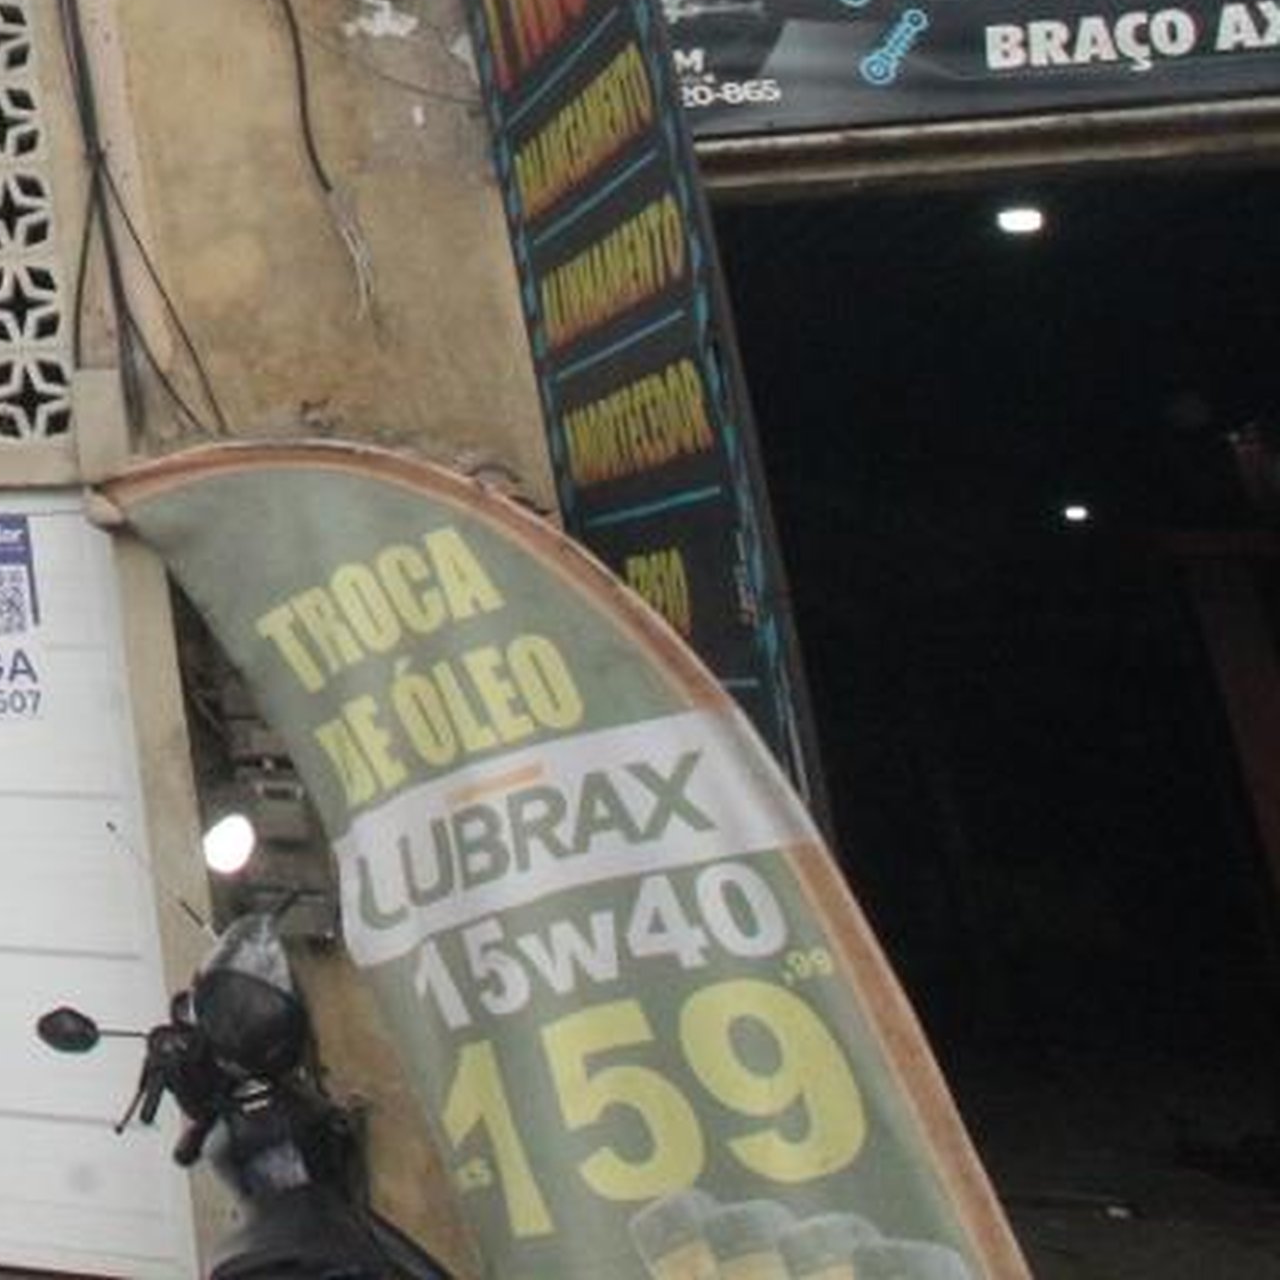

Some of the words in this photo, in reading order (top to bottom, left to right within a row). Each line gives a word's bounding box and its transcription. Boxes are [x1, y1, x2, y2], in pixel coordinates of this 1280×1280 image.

[985, 8, 1198, 72] BRAÇO
[256, 526, 505, 694] TROCA
[392, 632, 585, 768] ÓLEO
[355, 750, 718, 932] LUBRAX
[442, 977, 868, 1241] 159
